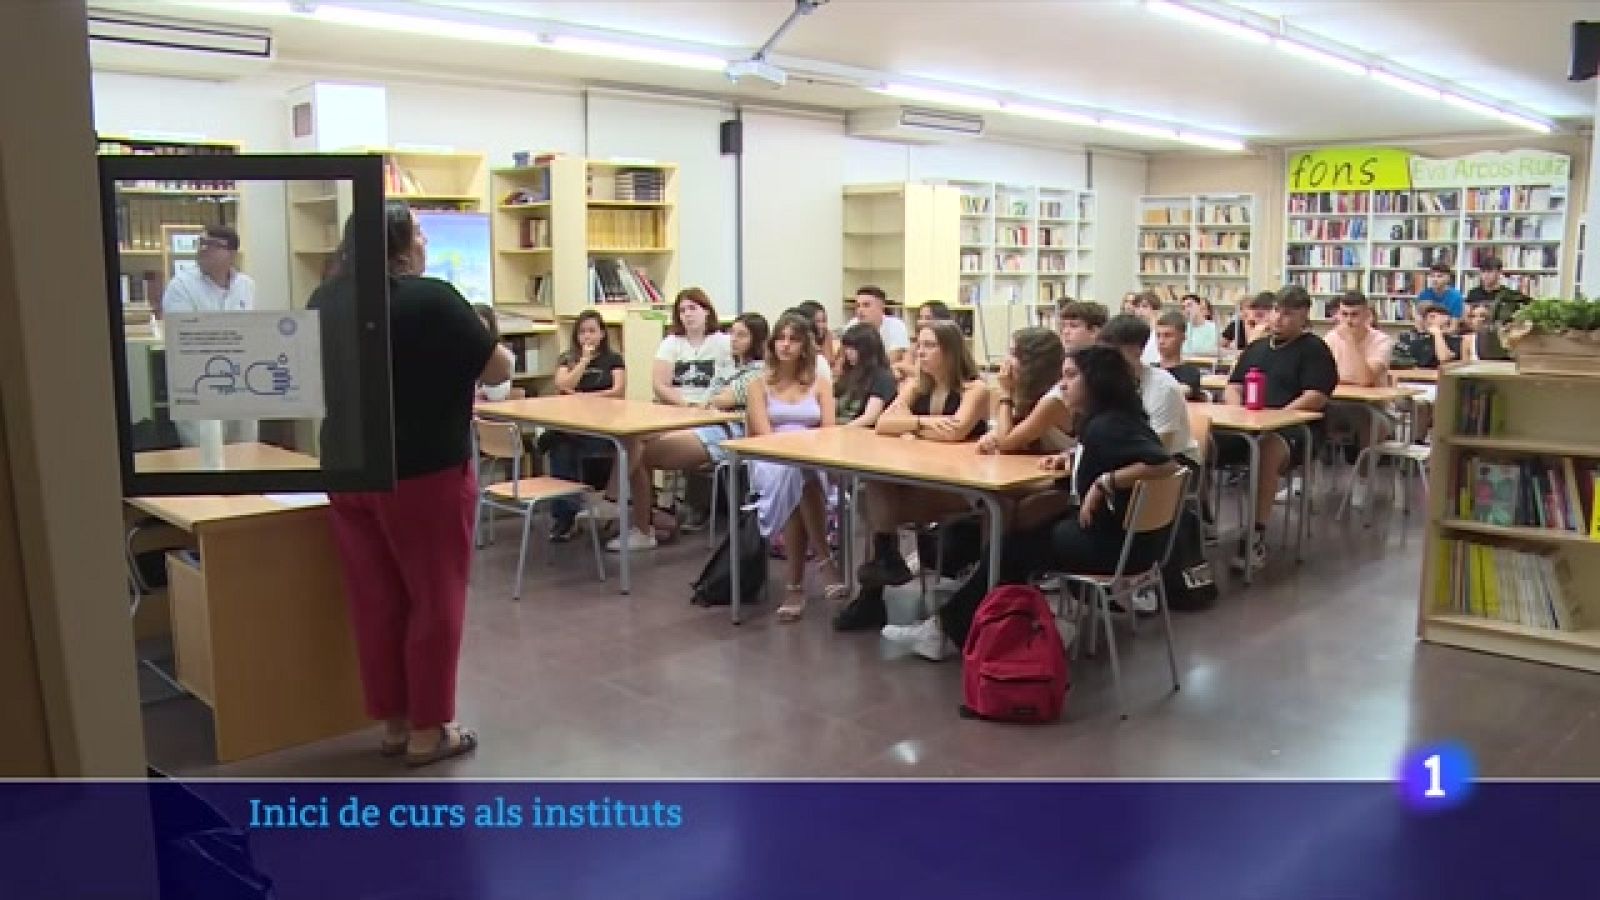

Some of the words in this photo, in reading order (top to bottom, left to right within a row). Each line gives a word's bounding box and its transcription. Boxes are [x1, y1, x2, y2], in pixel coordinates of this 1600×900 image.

[1293, 154, 1378, 188] fons
[1413, 159, 1447, 181] Eva
[1453, 158, 1513, 180] Arcos
